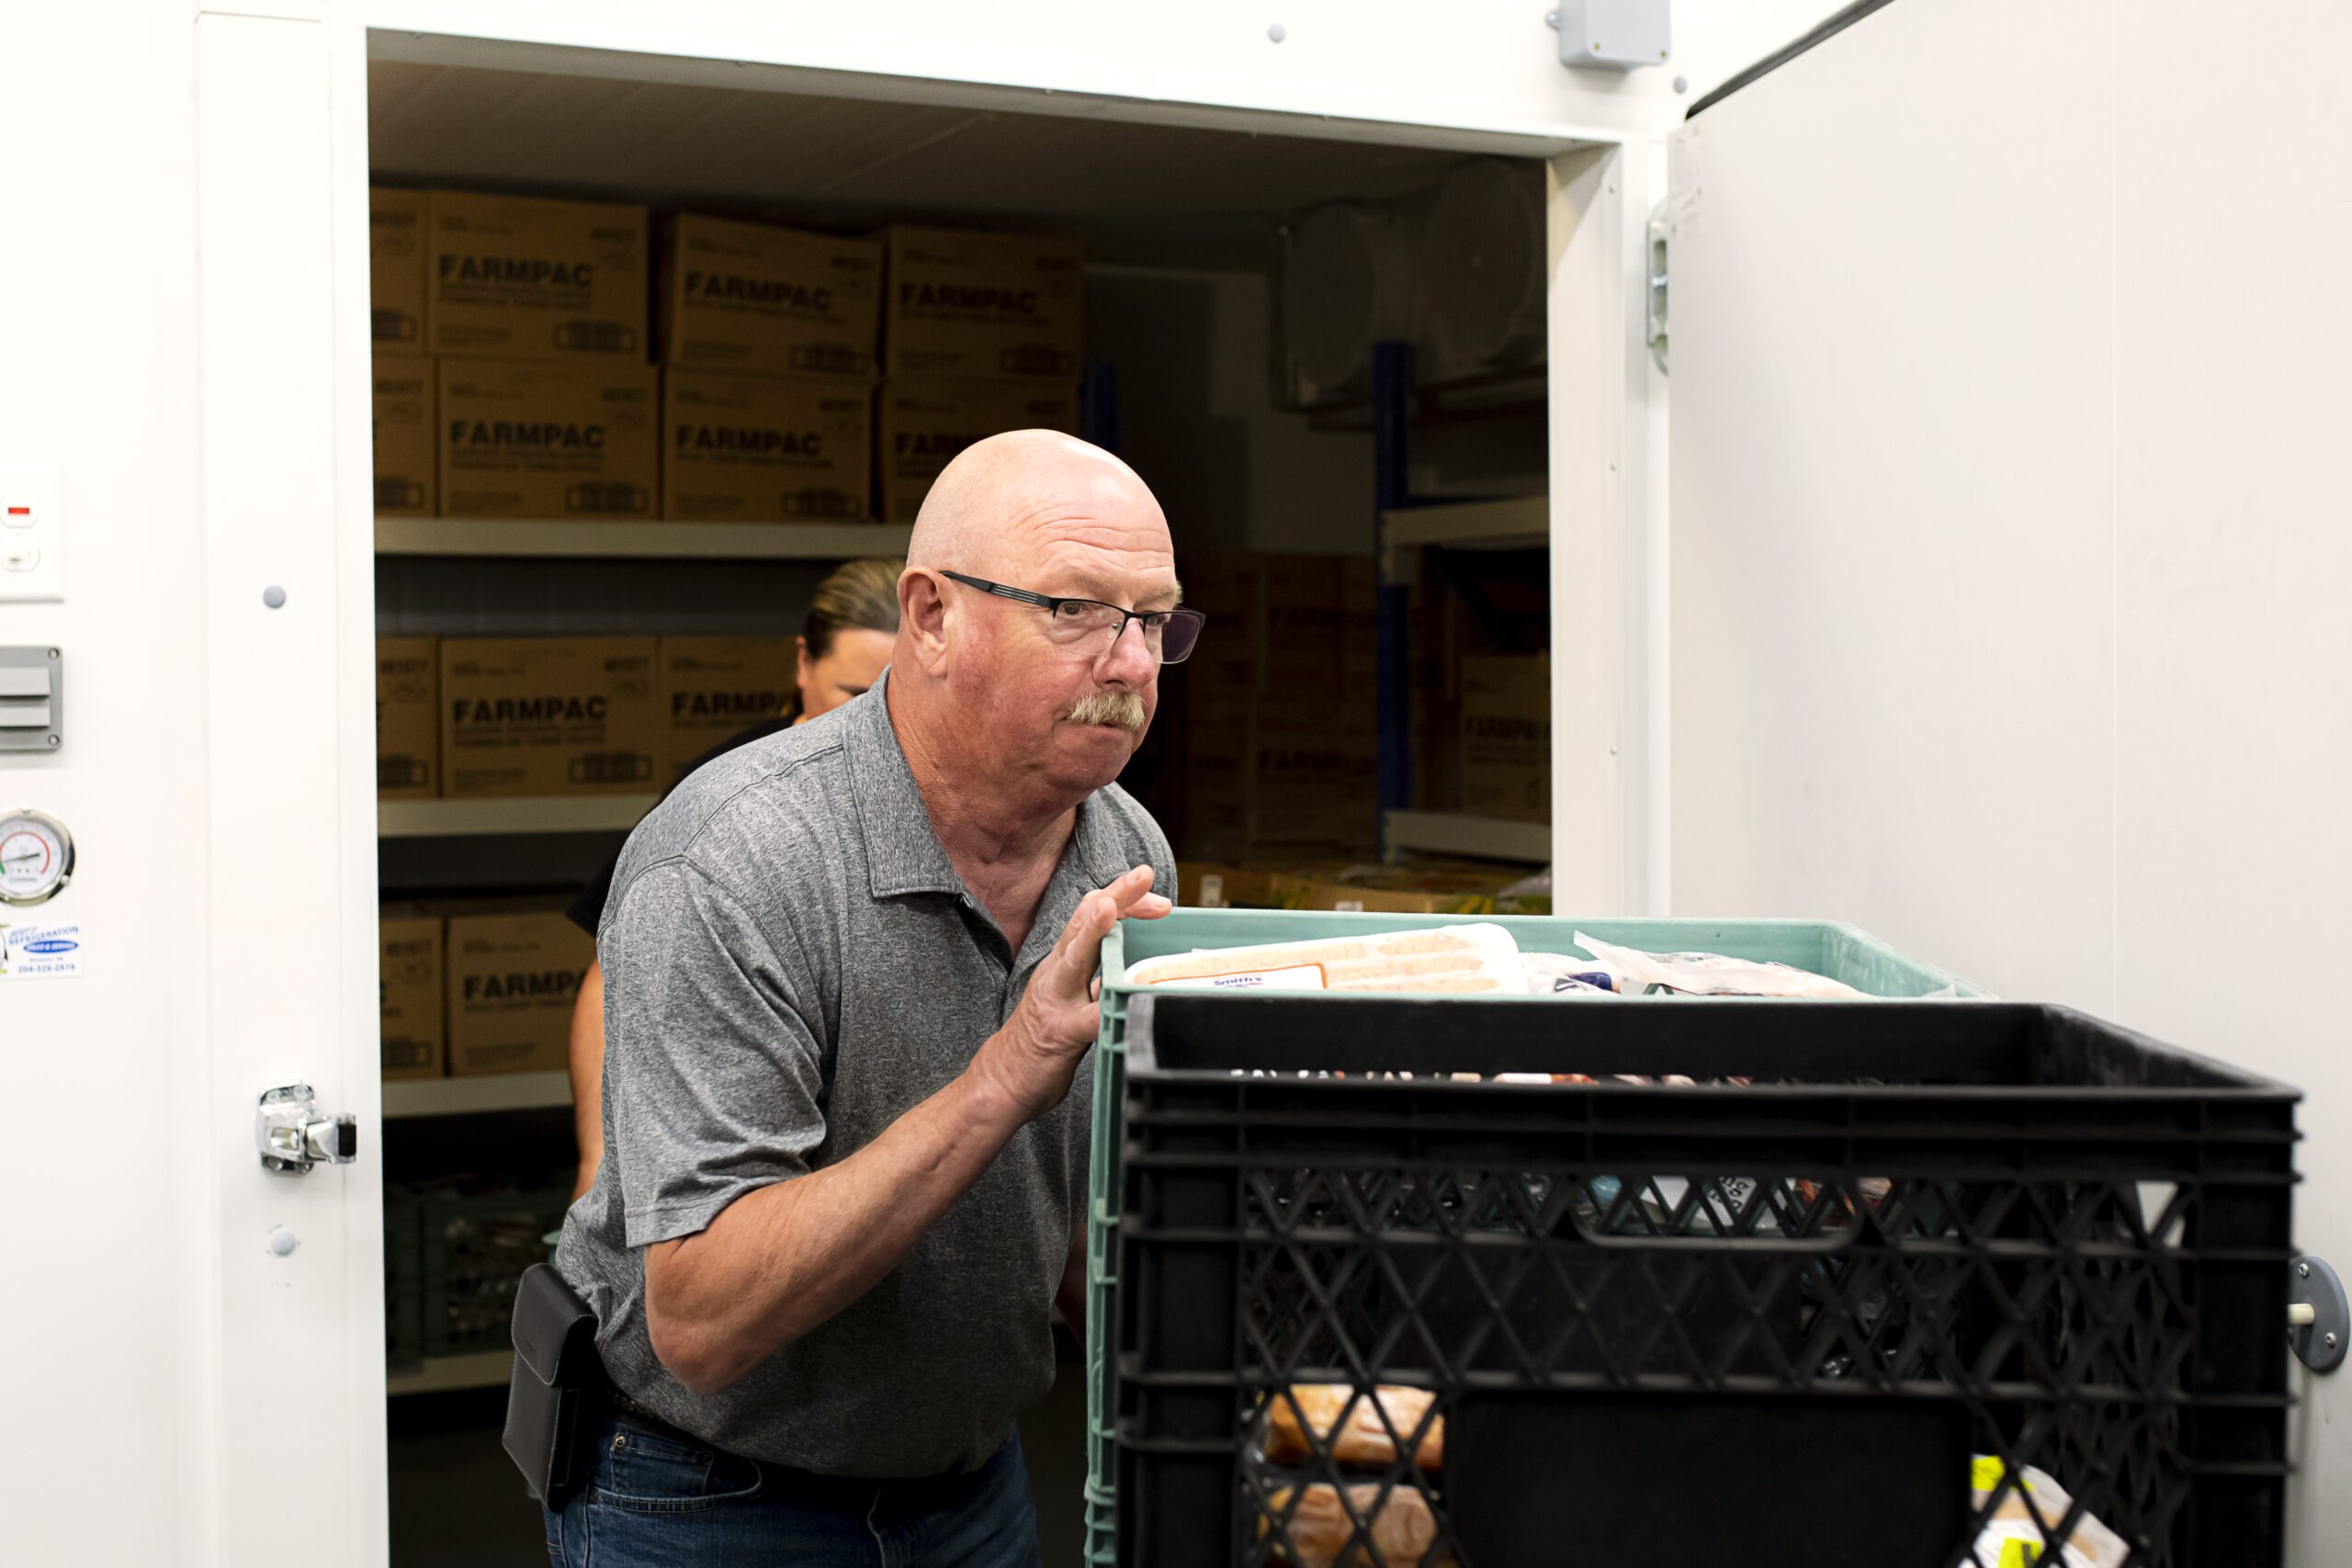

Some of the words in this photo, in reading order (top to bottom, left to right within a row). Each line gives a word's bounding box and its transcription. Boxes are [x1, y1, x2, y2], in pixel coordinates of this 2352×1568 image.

[439, 254, 594, 287] FARMPAC
[685, 272, 833, 311] FARMPAC
[900, 283, 1039, 314] FARMPAC
[450, 422, 606, 450] FARMPAC
[677, 425, 821, 457] FARMPAC
[454, 696, 608, 724] FARMPAC
[9, 926, 79, 945] REFRIGERATION
